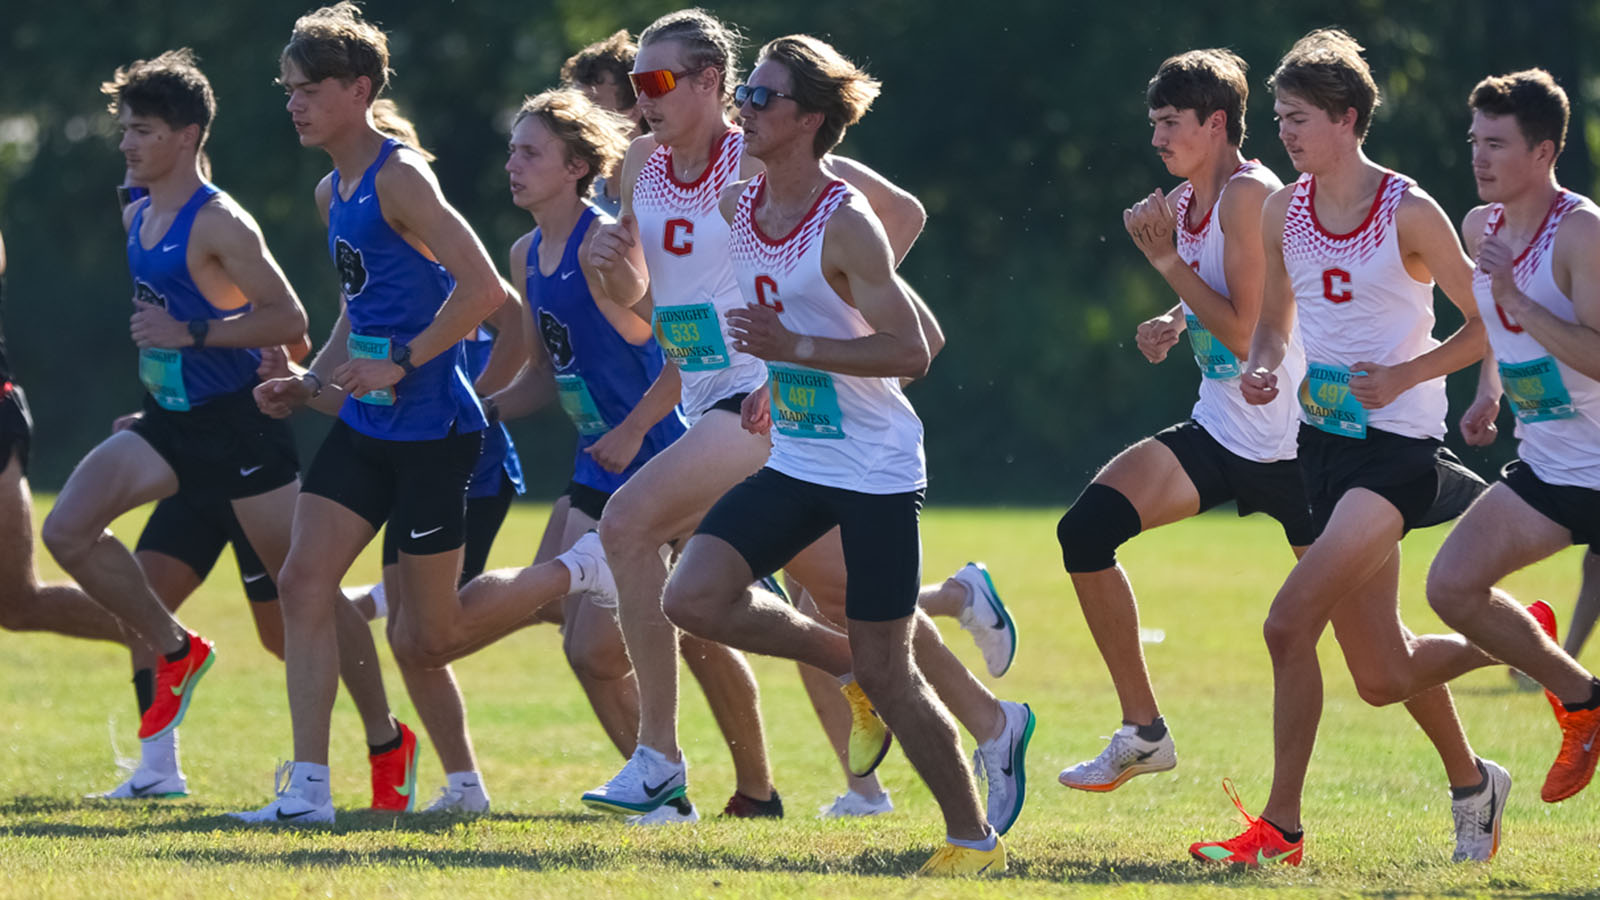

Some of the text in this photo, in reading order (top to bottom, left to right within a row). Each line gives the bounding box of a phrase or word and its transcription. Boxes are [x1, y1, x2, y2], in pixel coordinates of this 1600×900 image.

[664, 218, 694, 256] C
[754, 275, 784, 313] C
[1322, 267, 1352, 304] C
[655, 308, 711, 323] MIDNIGHT
[671, 323, 700, 343] 533
[666, 344, 716, 358] MADNESS
[771, 370, 830, 388] MIDNIGHT
[1309, 366, 1351, 385] MIDNIG
[788, 386, 817, 408] 487
[1317, 382, 1349, 404] 497
[777, 409, 831, 426] MADNESS
[1305, 404, 1357, 423] MADNESS
